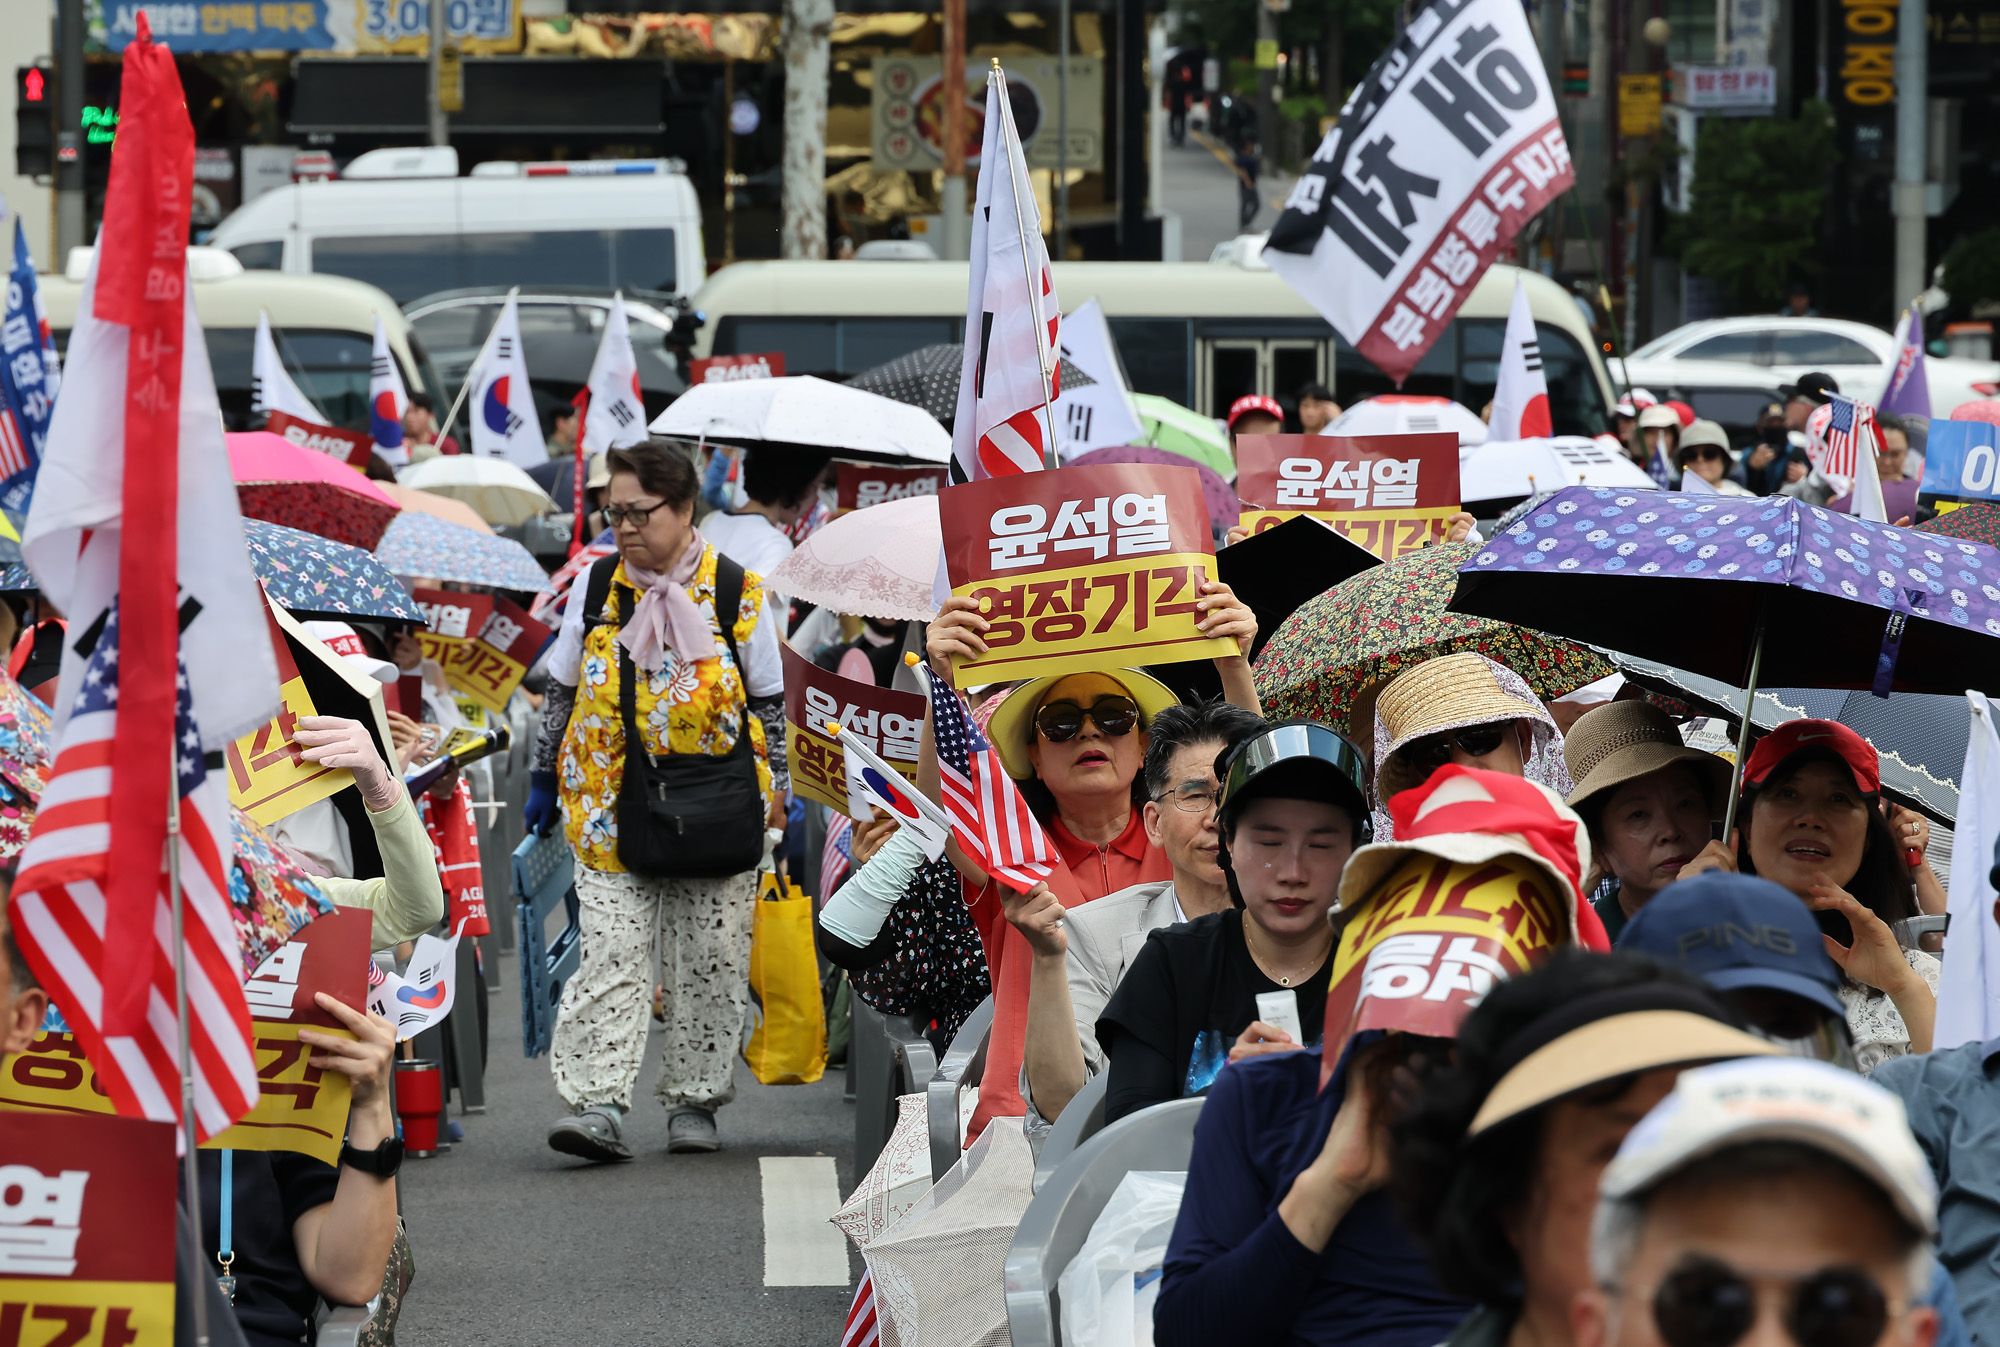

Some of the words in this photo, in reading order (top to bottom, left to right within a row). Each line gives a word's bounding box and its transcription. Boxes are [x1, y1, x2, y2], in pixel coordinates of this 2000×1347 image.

[367, 0, 507, 39] 3,00원
[1276, 457, 1421, 508] 윤석열
[988, 493, 1173, 571] 윤석열
[974, 564, 1211, 650] 영장기각
[804, 685, 925, 762] 윤석열
[1676, 921, 1798, 961] PING
